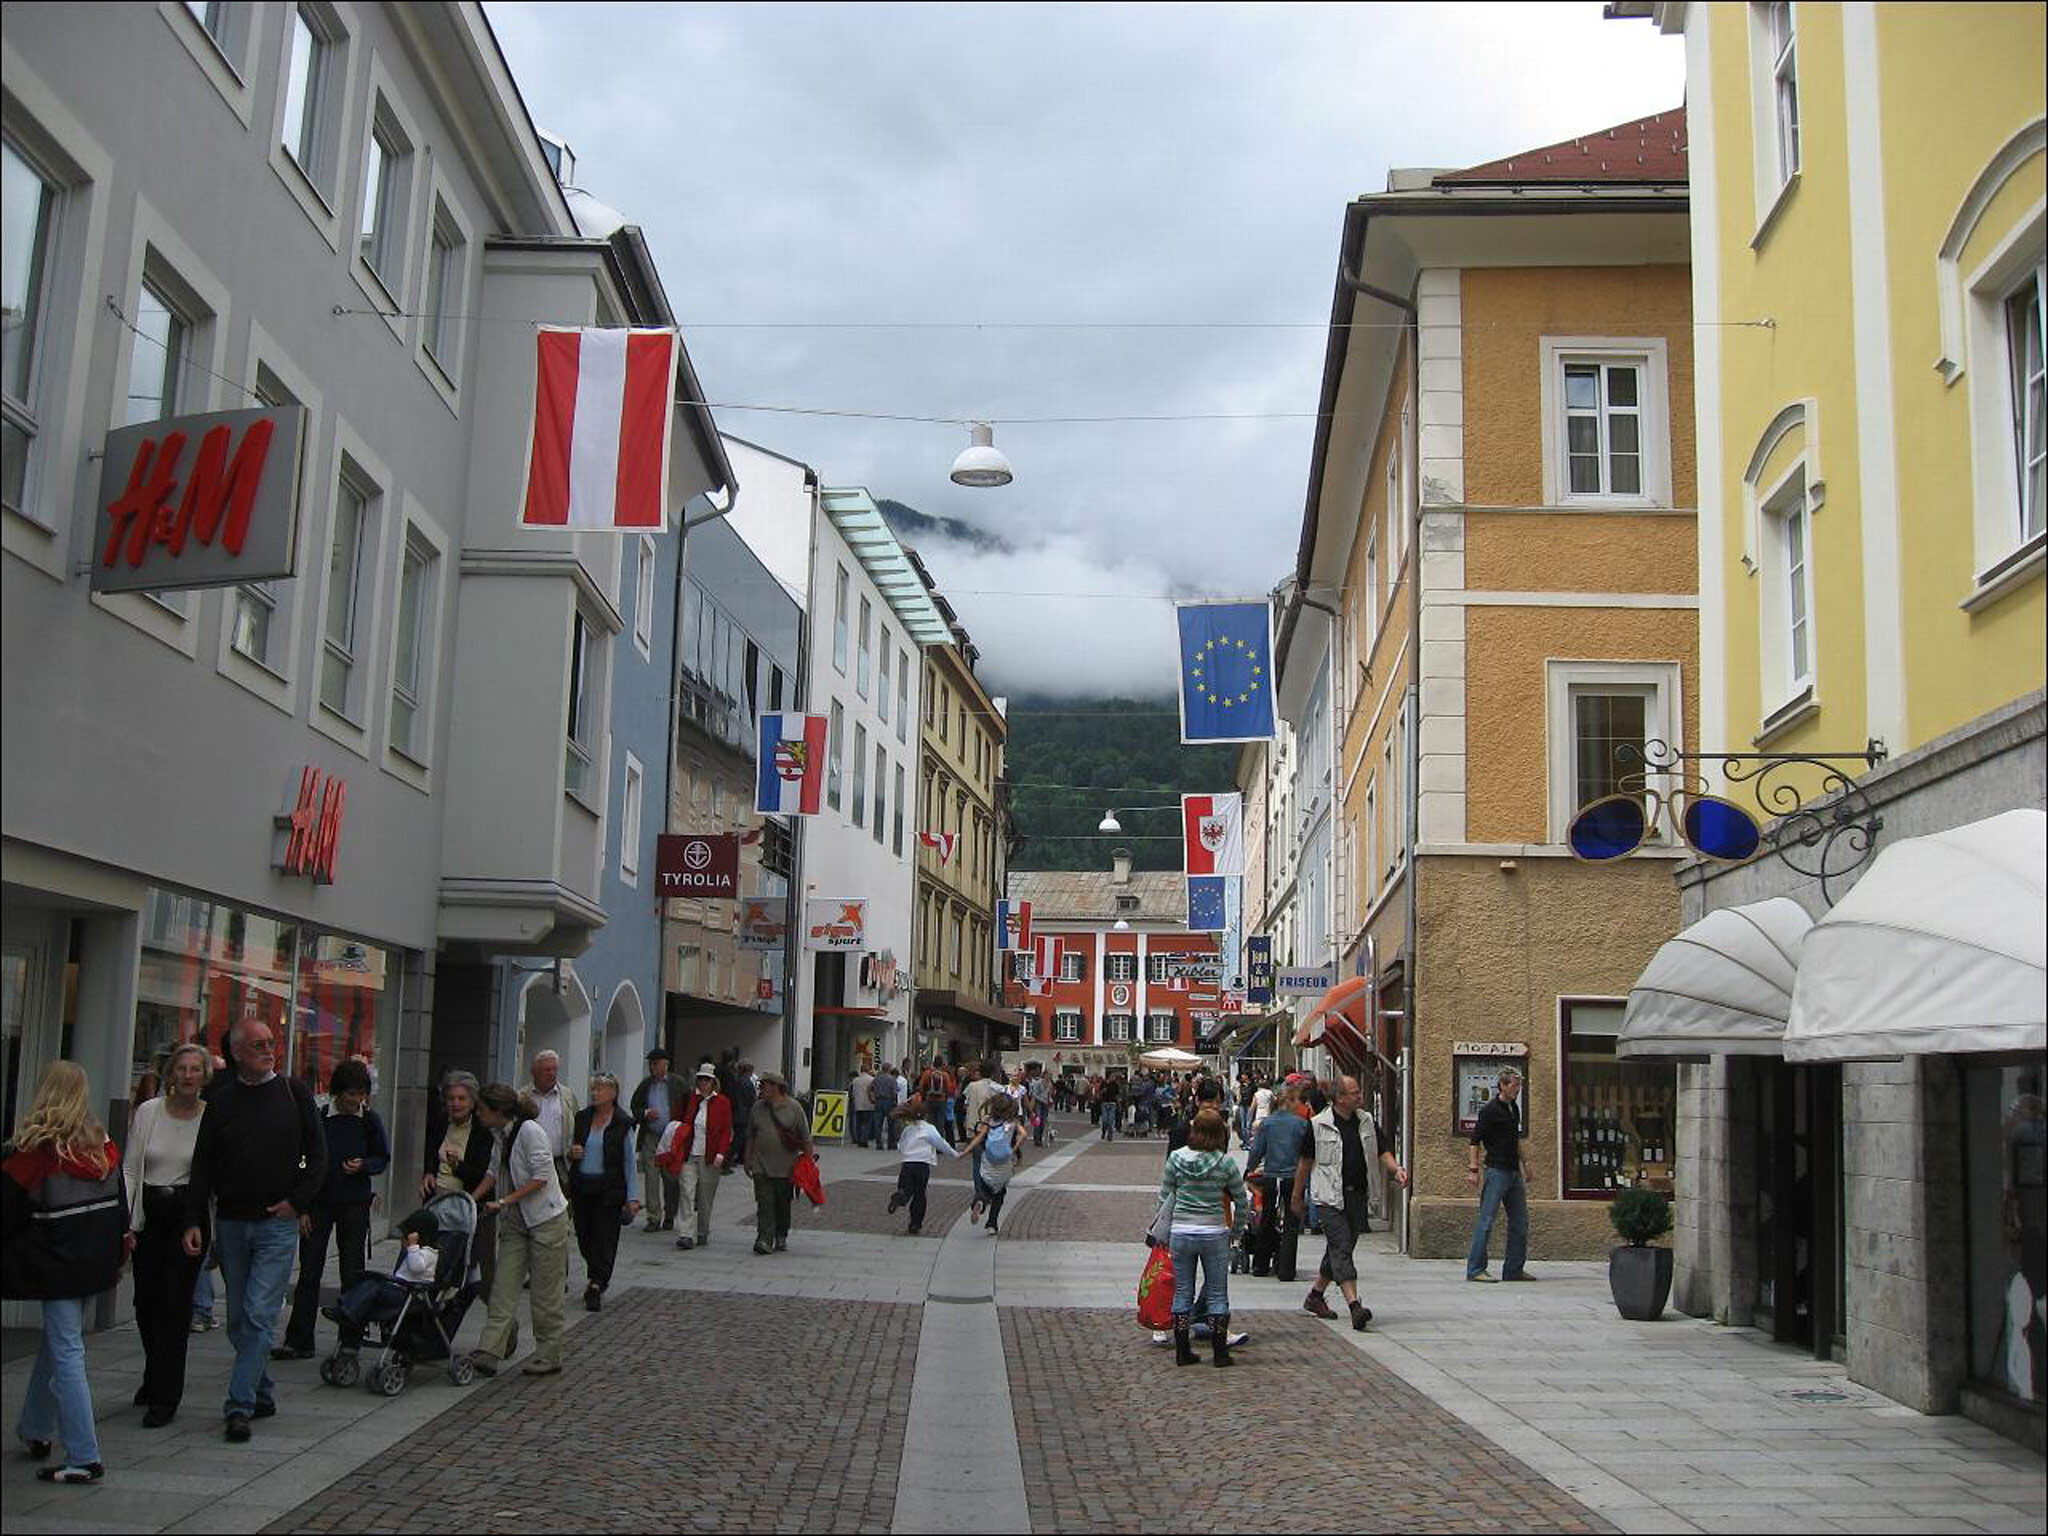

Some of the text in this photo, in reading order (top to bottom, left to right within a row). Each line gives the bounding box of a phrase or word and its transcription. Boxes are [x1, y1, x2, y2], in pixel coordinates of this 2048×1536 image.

[102, 417, 274, 568] H&M
[662, 873, 731, 887] TYROLIA
[1279, 976, 1328, 988] FRISEUR
